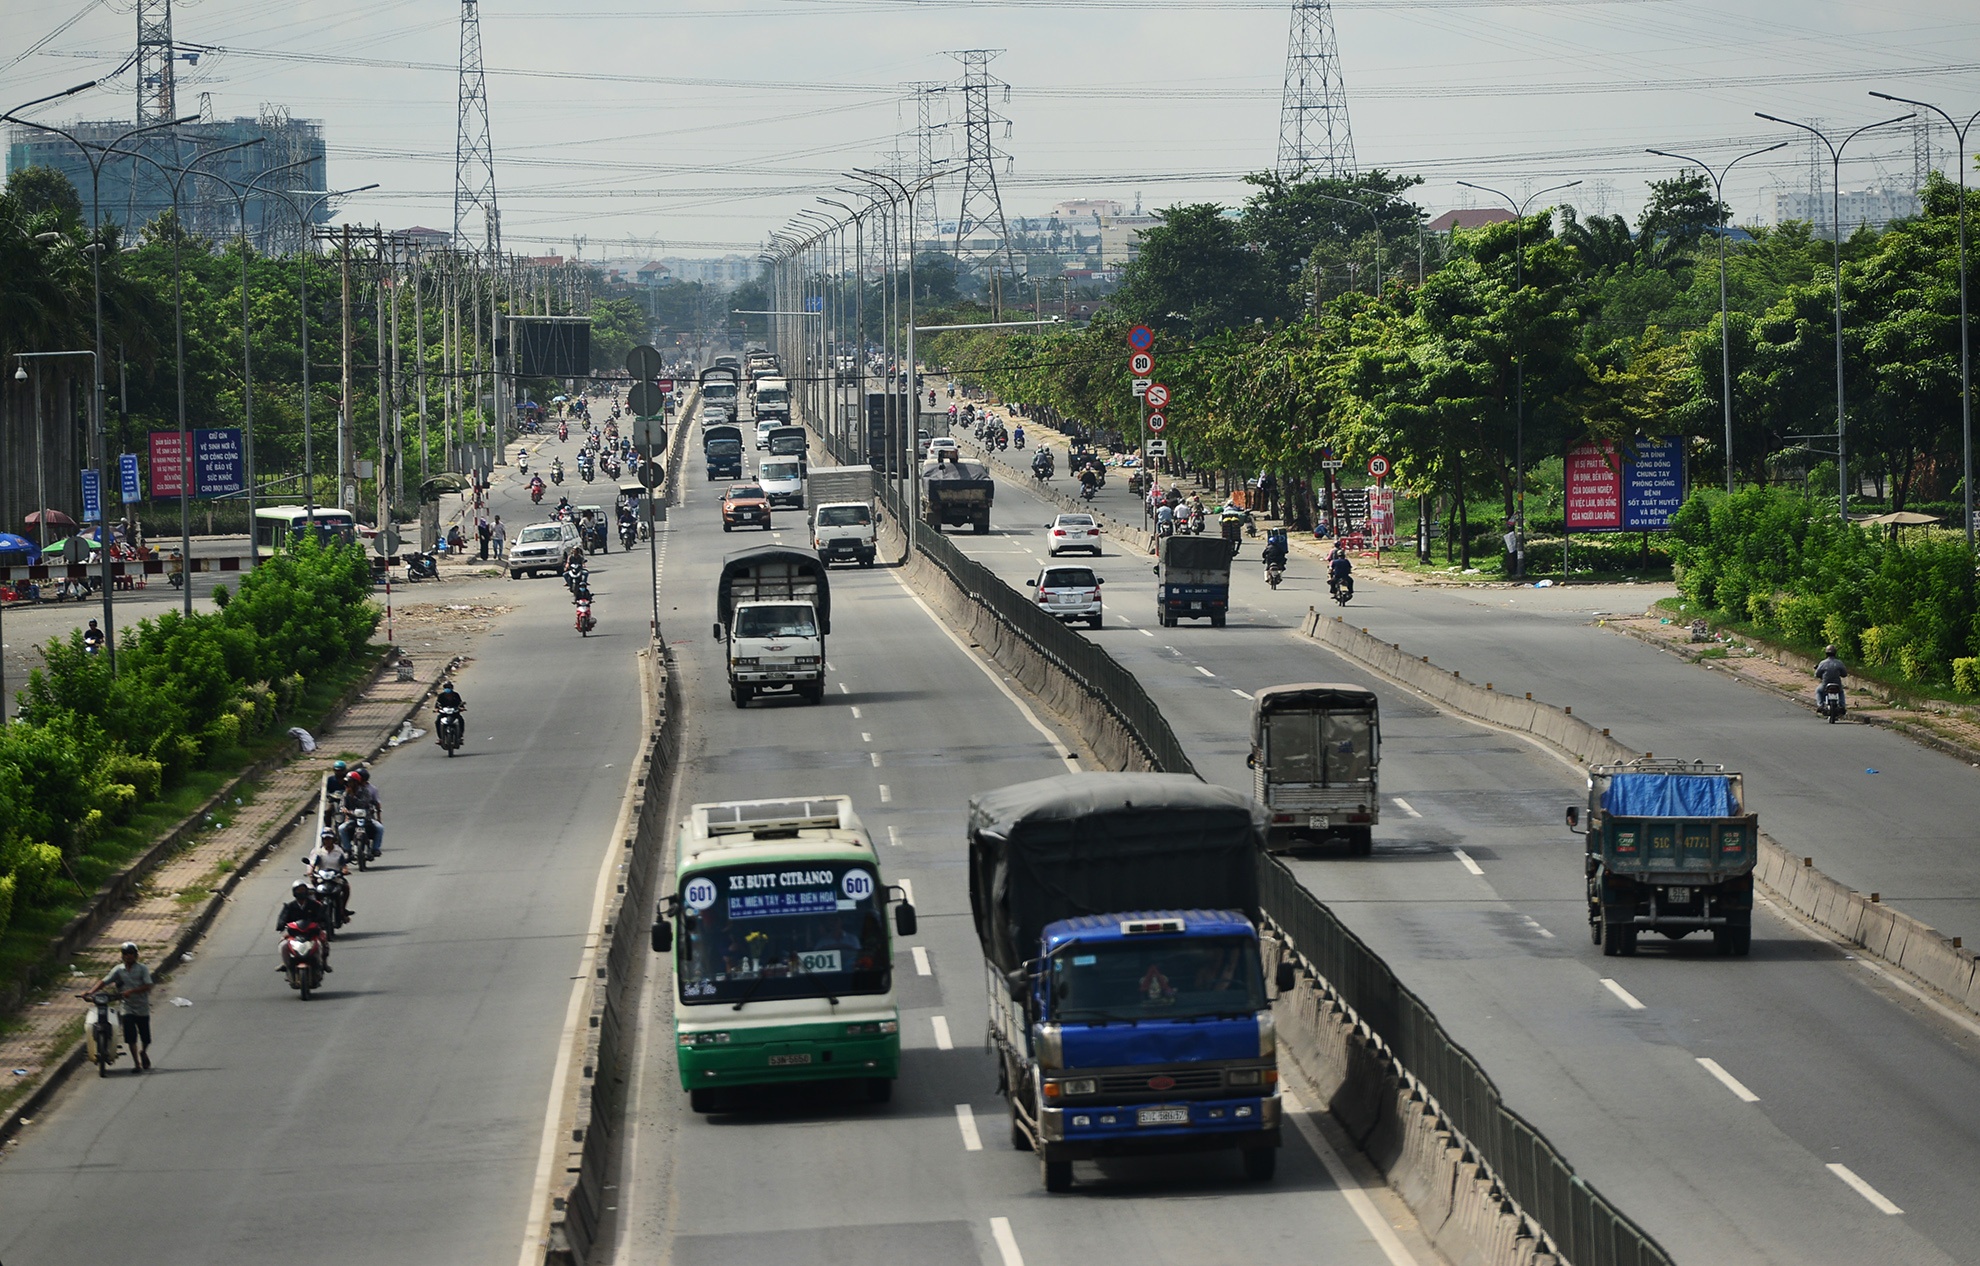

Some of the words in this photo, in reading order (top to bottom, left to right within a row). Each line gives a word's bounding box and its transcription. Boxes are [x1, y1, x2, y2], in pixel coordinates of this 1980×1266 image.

[1135, 357, 1147, 369] 80
[1152, 417, 1162, 428] 60
[1373, 461, 1384, 472] 50
[1653, 837, 1670, 848] 51C
[729, 876, 744, 890] XE
[746, 874, 777, 888] BUYT
[780, 870, 834, 886] CITRANCO
[846, 877, 870, 893] 601
[689, 885, 712, 902] 601
[804, 954, 836, 969] 601
